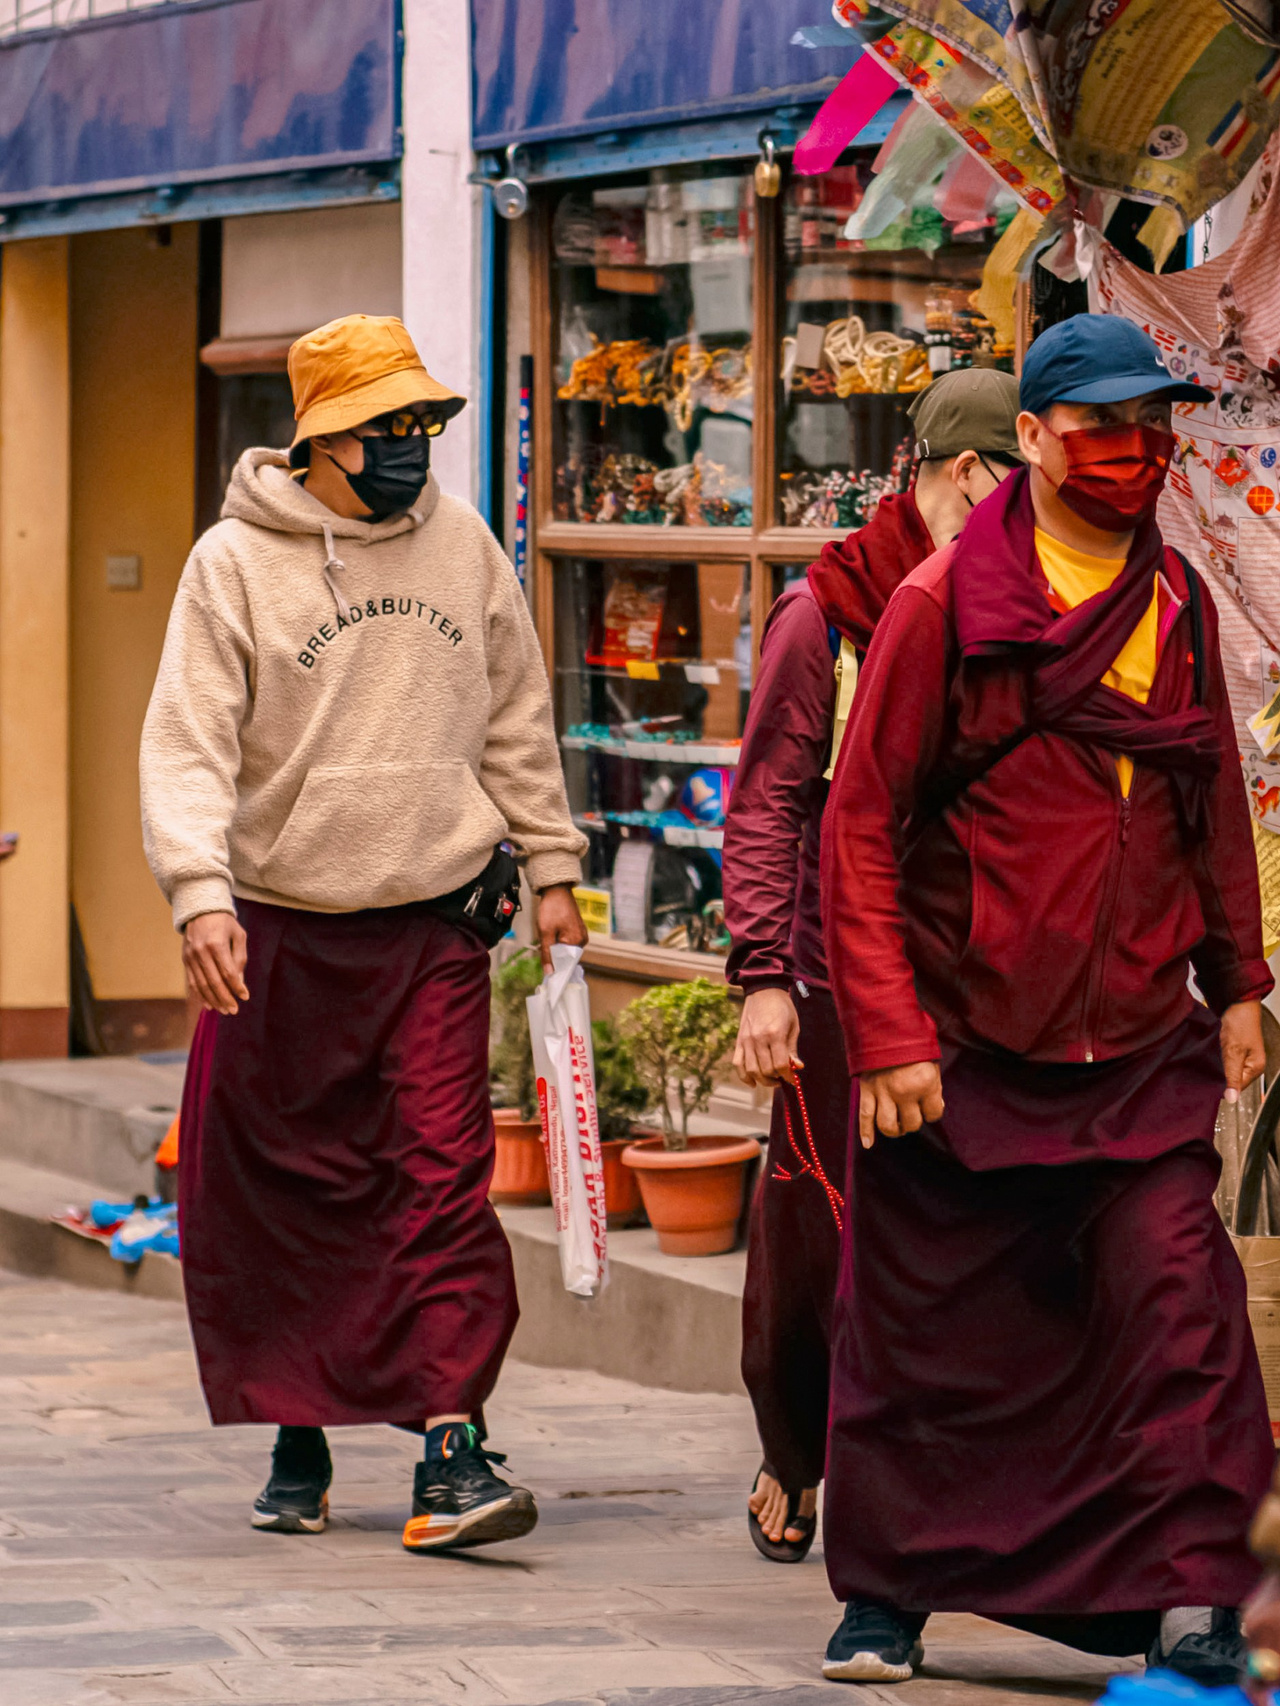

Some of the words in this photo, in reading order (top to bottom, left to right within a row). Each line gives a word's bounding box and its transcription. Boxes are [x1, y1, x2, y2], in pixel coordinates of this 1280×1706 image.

[297, 597, 463, 669] BREAD&BUTTER
[549, 1086, 558, 1111] Nepal
[550, 1114, 560, 1167] Kathmandu,
